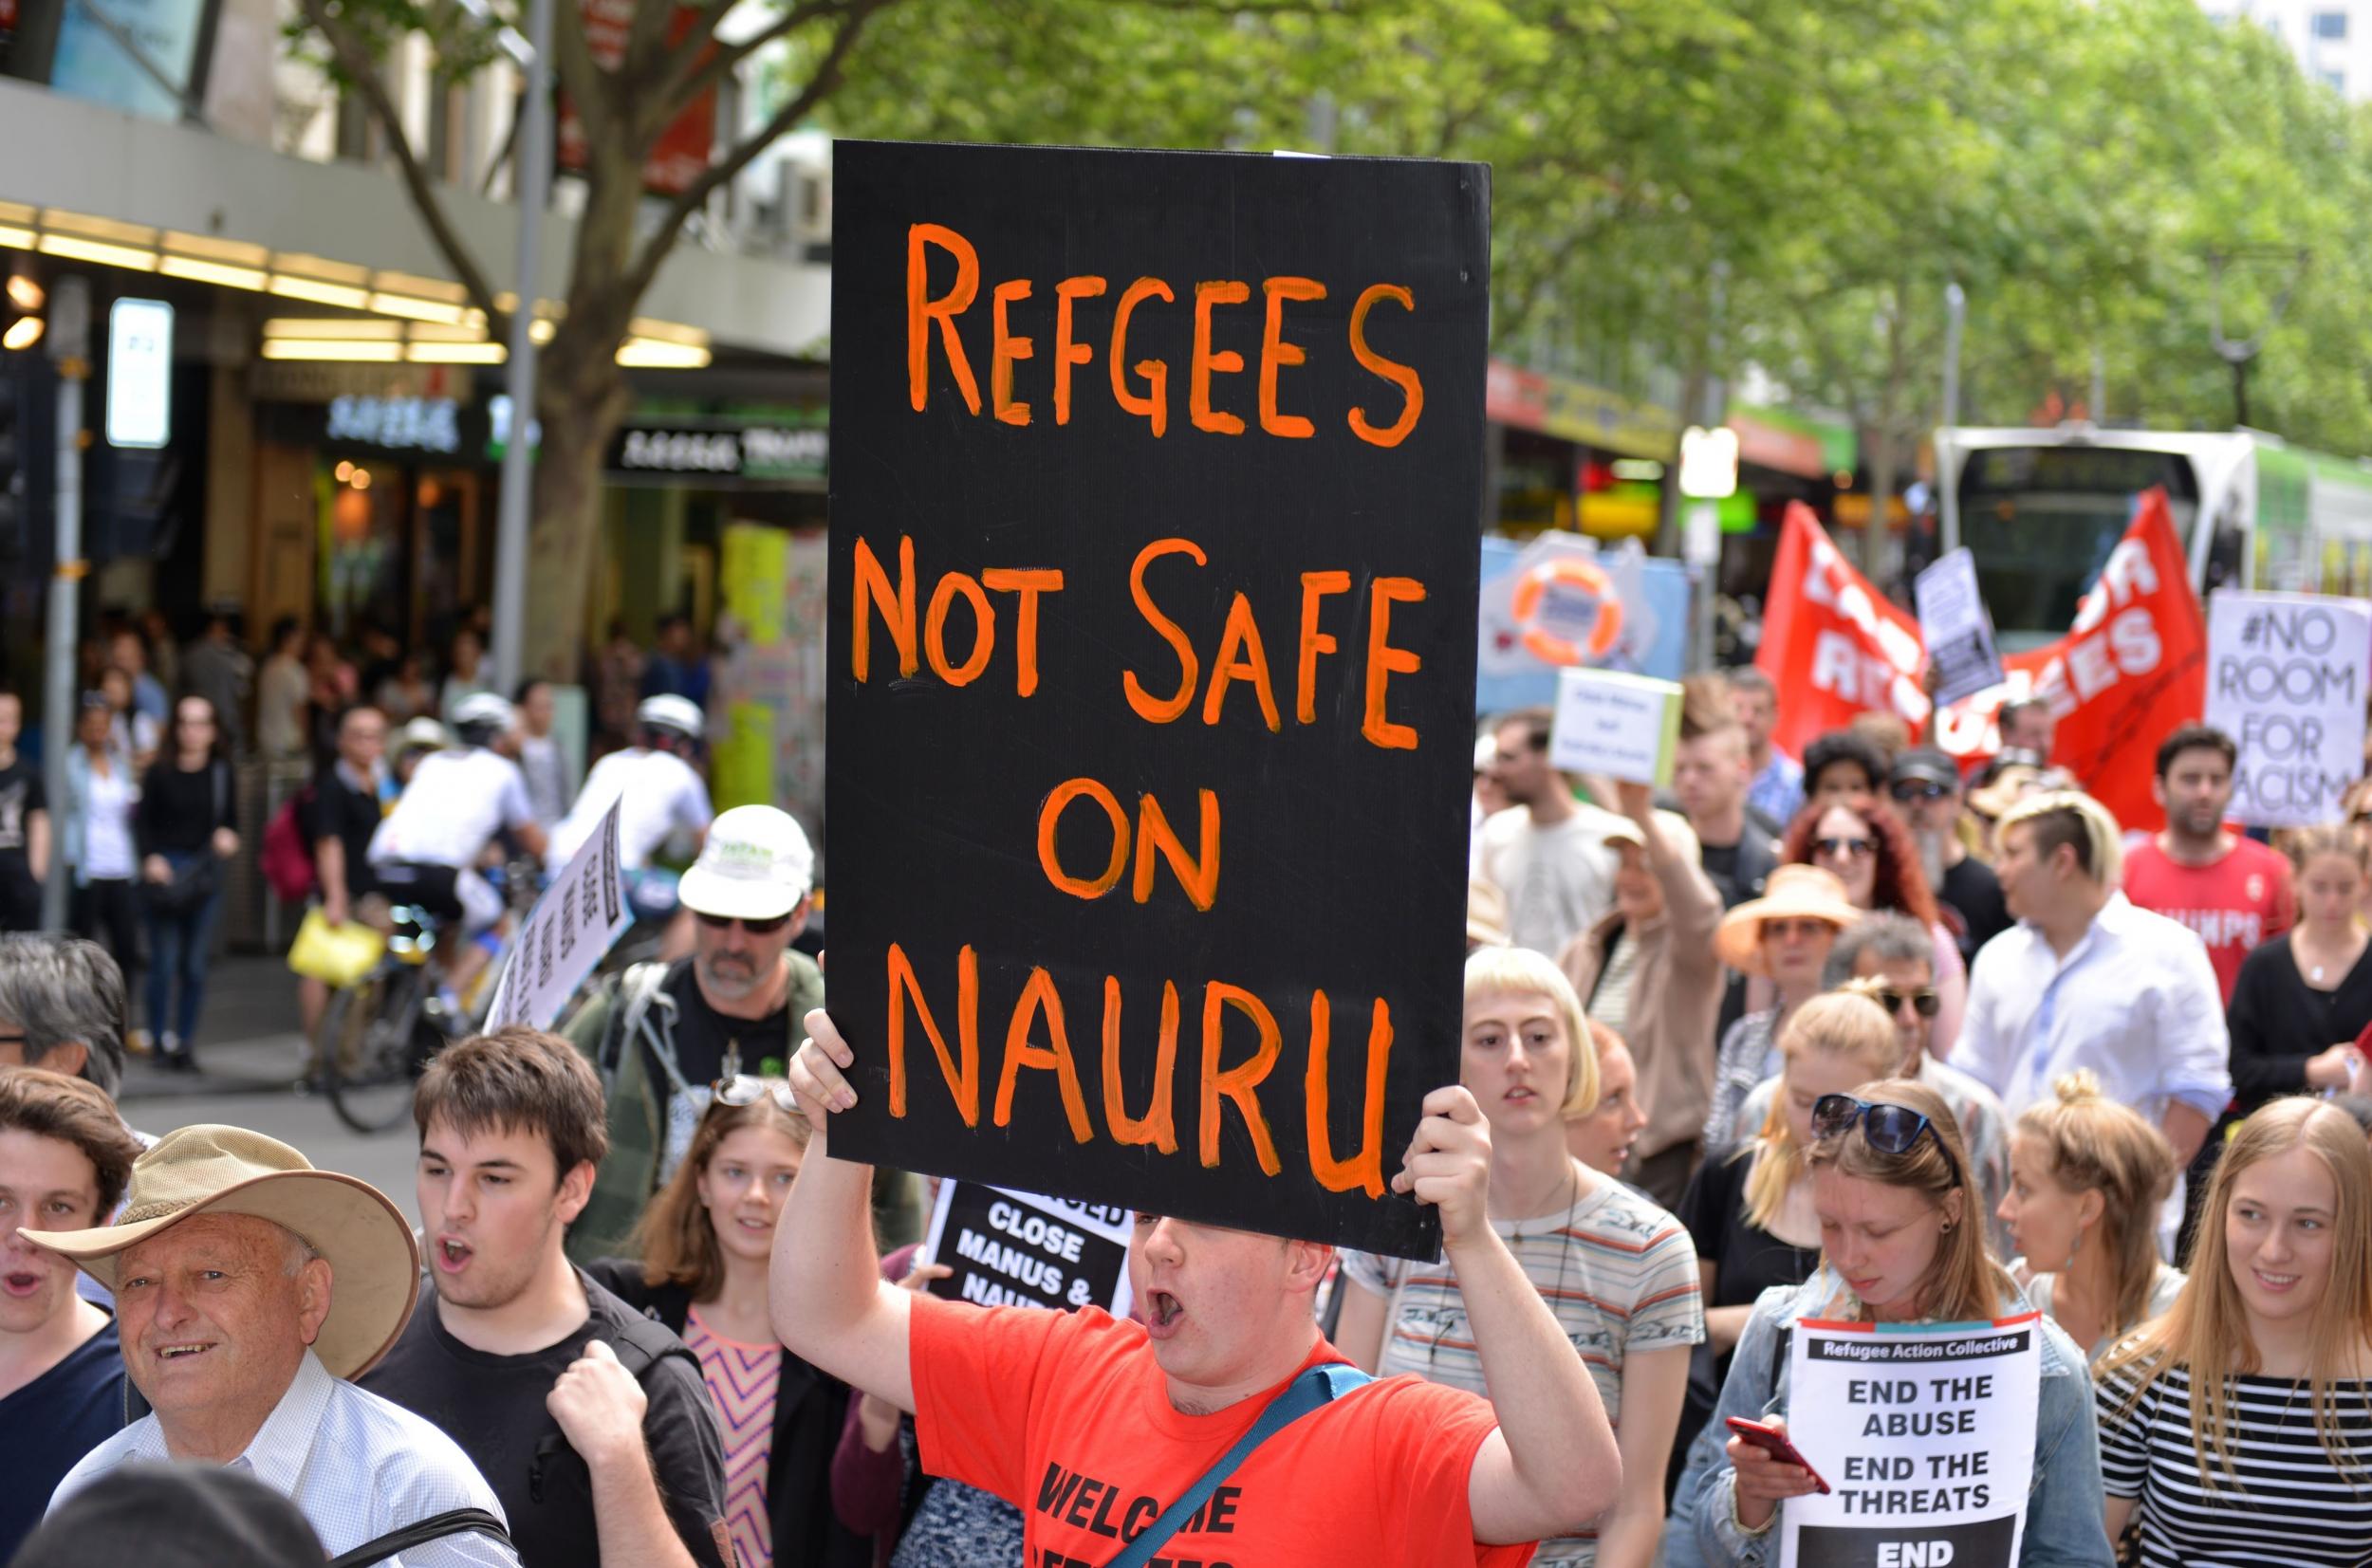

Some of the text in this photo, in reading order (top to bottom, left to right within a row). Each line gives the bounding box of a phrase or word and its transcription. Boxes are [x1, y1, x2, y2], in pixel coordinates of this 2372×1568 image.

[908, 224, 1423, 448] REFGEES
[854, 535, 1426, 750] NOT SAFE
[2242, 608, 2336, 656] #NO
[2218, 655, 2356, 705] ROOM
[2241, 711, 2324, 763] FOR
[2232, 763, 2351, 814] ACISM
[1038, 778, 1220, 911] ON
[888, 943, 1394, 1200] NAURU
[988, 1201, 1085, 1264] CLOSE
[955, 1227, 1092, 1306] MANUS &
[1823, 1336, 2018, 1360] Refugee Action Collective
[1848, 1374, 1993, 1404] END THE
[1862, 1409, 1975, 1437] ABUSE
[1844, 1450, 1989, 1481] END THE
[1839, 1484, 1990, 1514] THREATS
[1877, 1540, 1955, 1568] END
